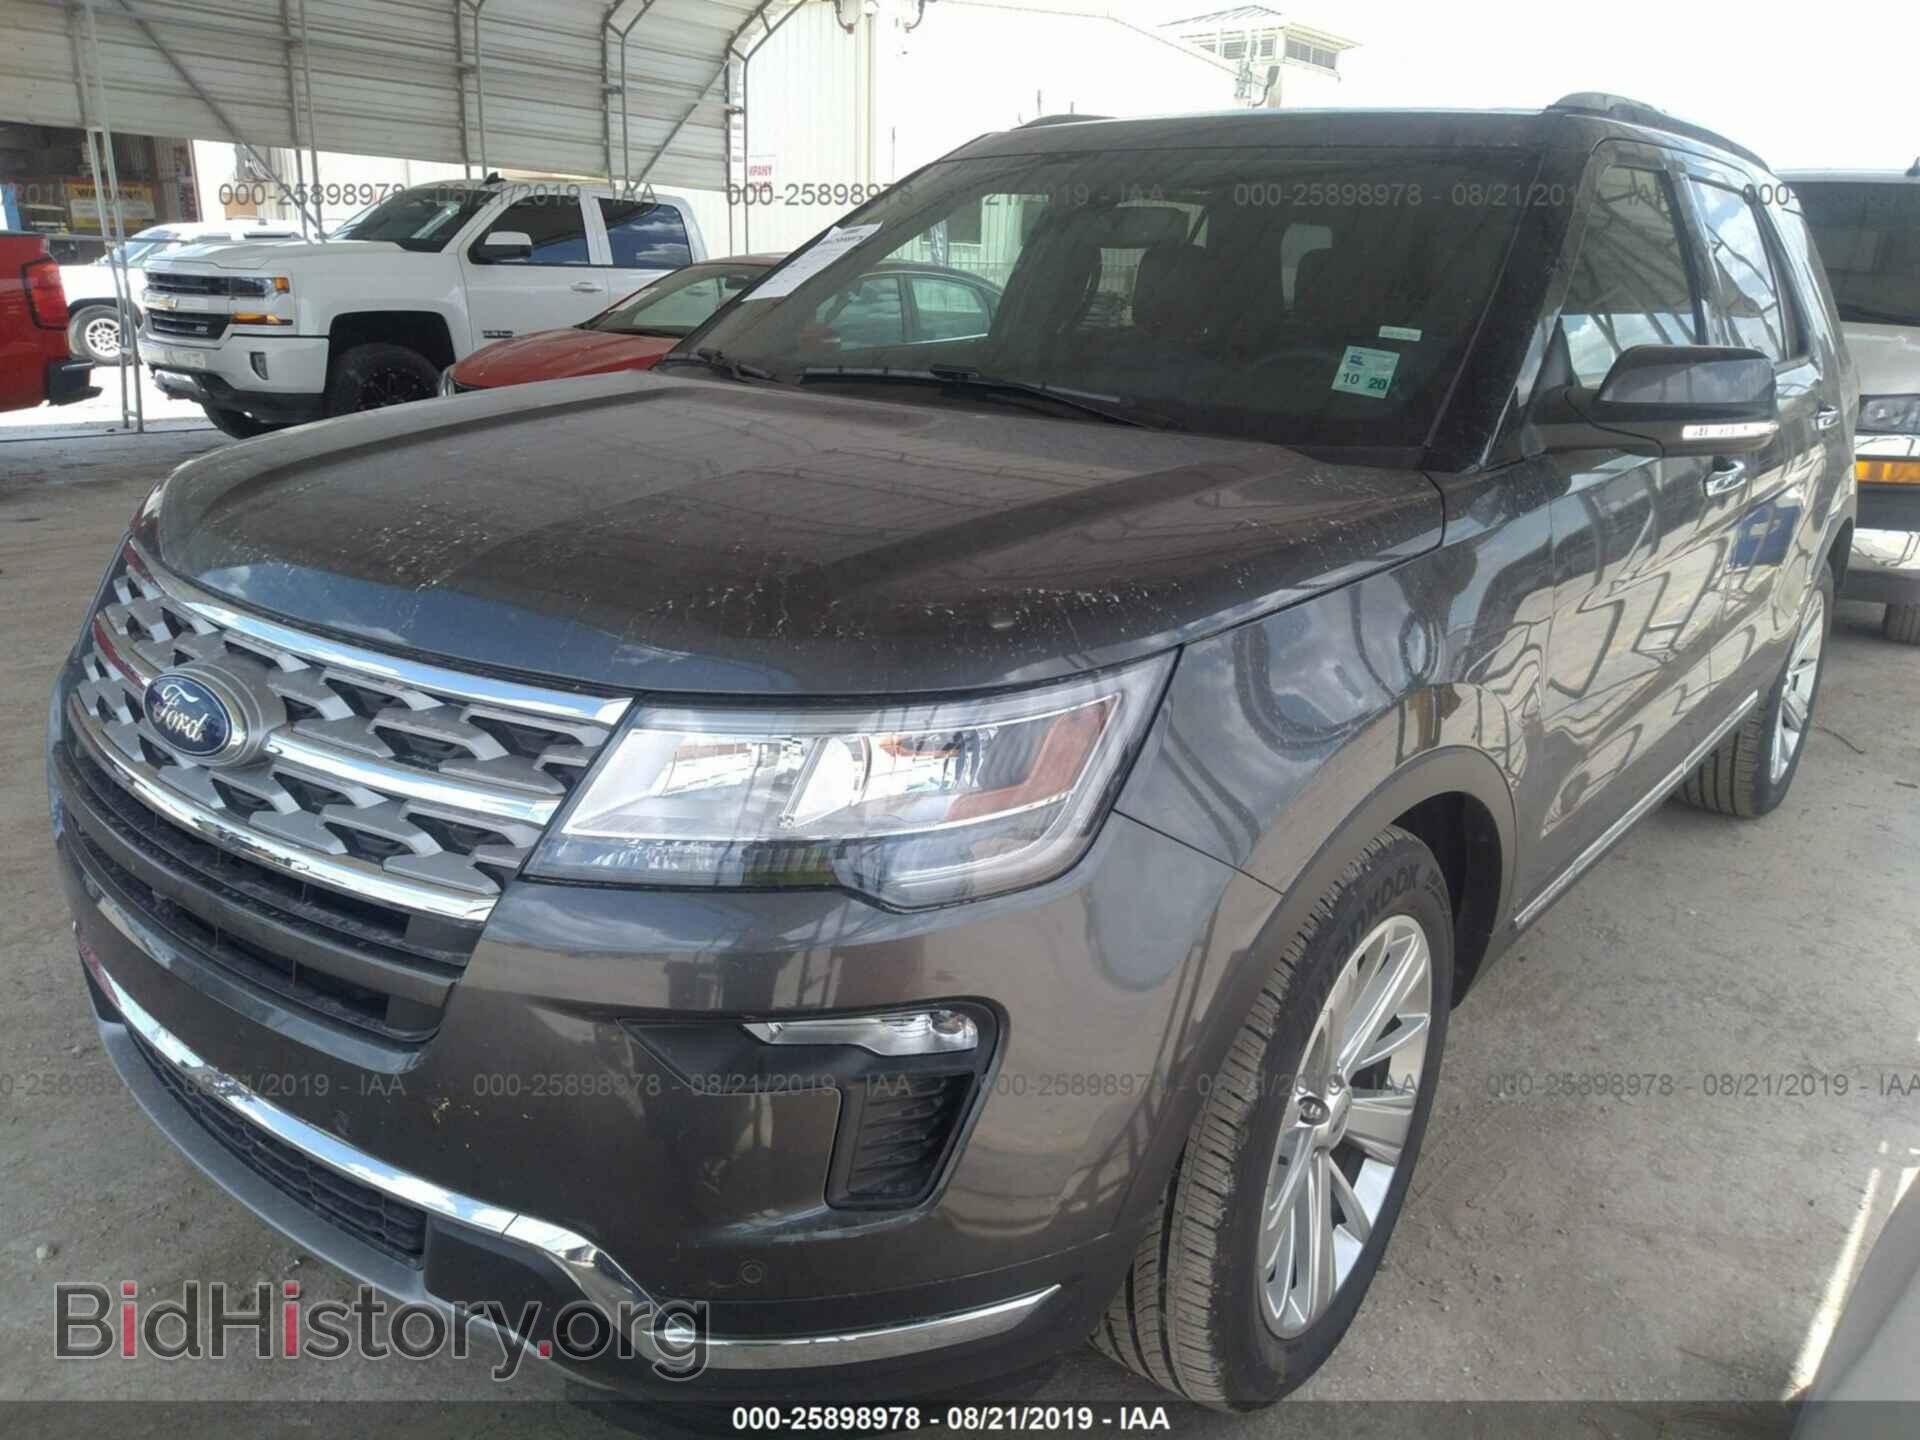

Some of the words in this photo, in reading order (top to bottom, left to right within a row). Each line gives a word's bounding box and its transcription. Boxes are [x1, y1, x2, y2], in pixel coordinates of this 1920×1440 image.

[1343, 372, 1360, 385] 10
[1367, 377, 1388, 391] 20
[153, 684, 209, 742] Ford
